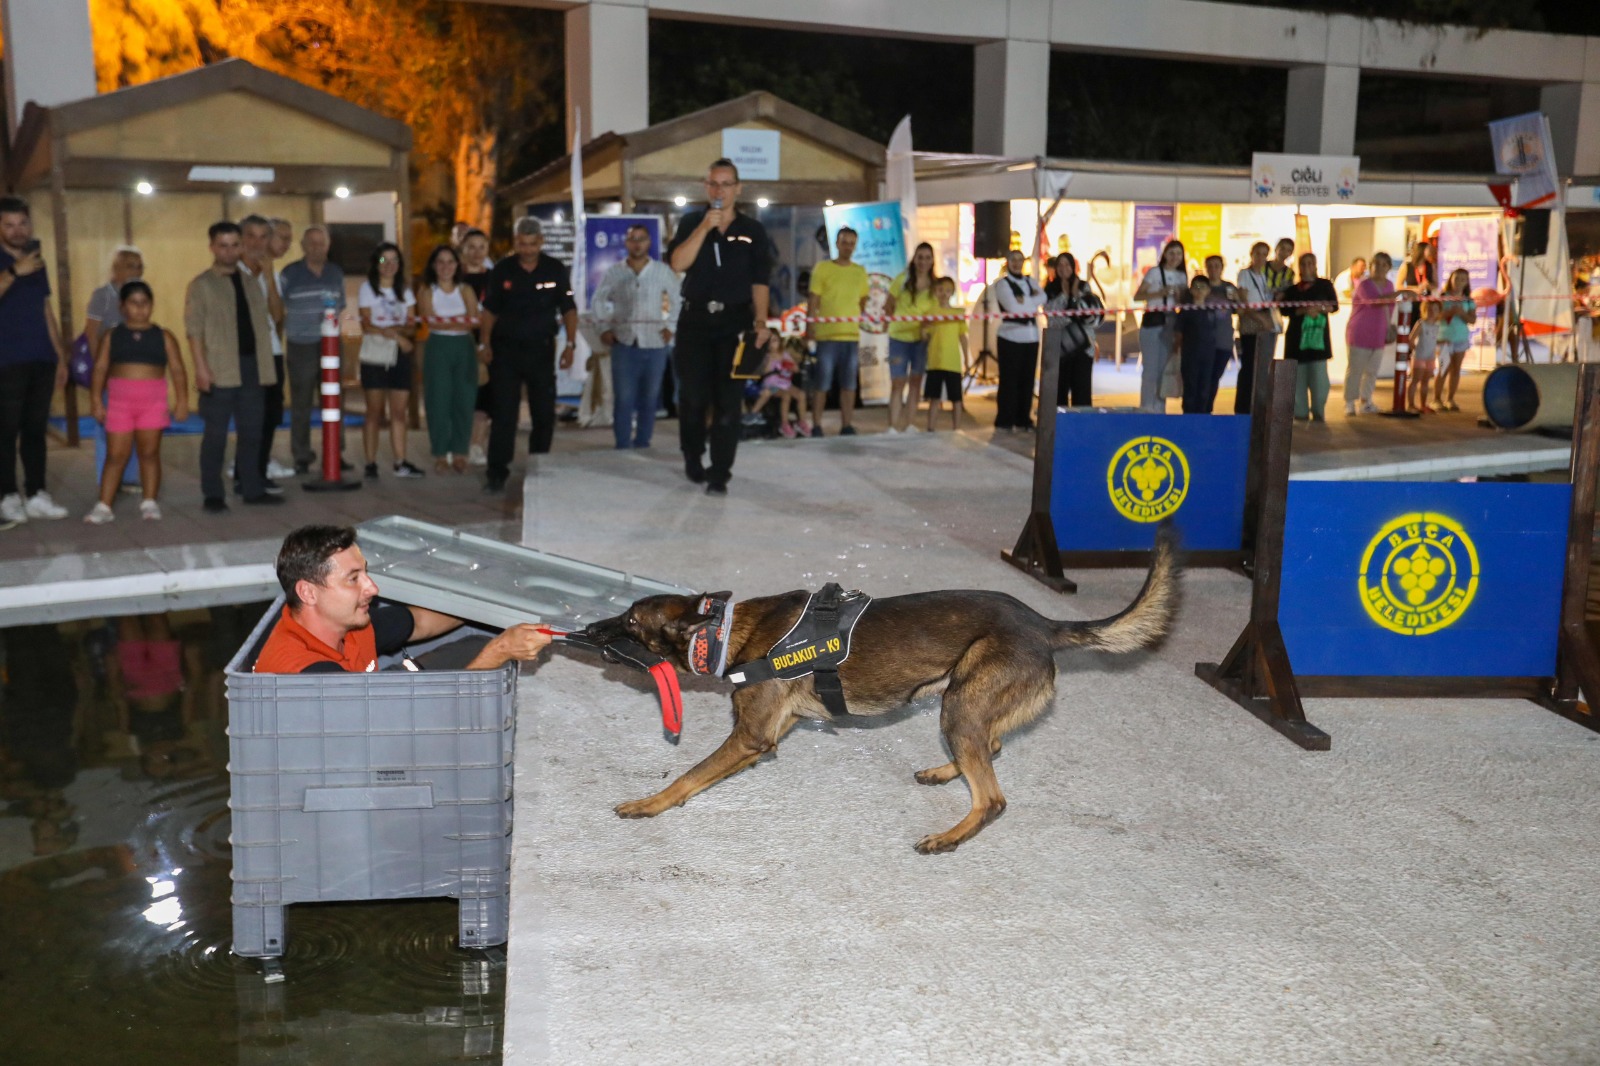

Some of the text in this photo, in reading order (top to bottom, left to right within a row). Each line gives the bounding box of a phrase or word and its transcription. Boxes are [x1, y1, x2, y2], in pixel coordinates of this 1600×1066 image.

[1388, 523, 1455, 548] BUCA
[772, 645, 818, 671] BUCAKUT
[826, 637, 841, 653] K9
